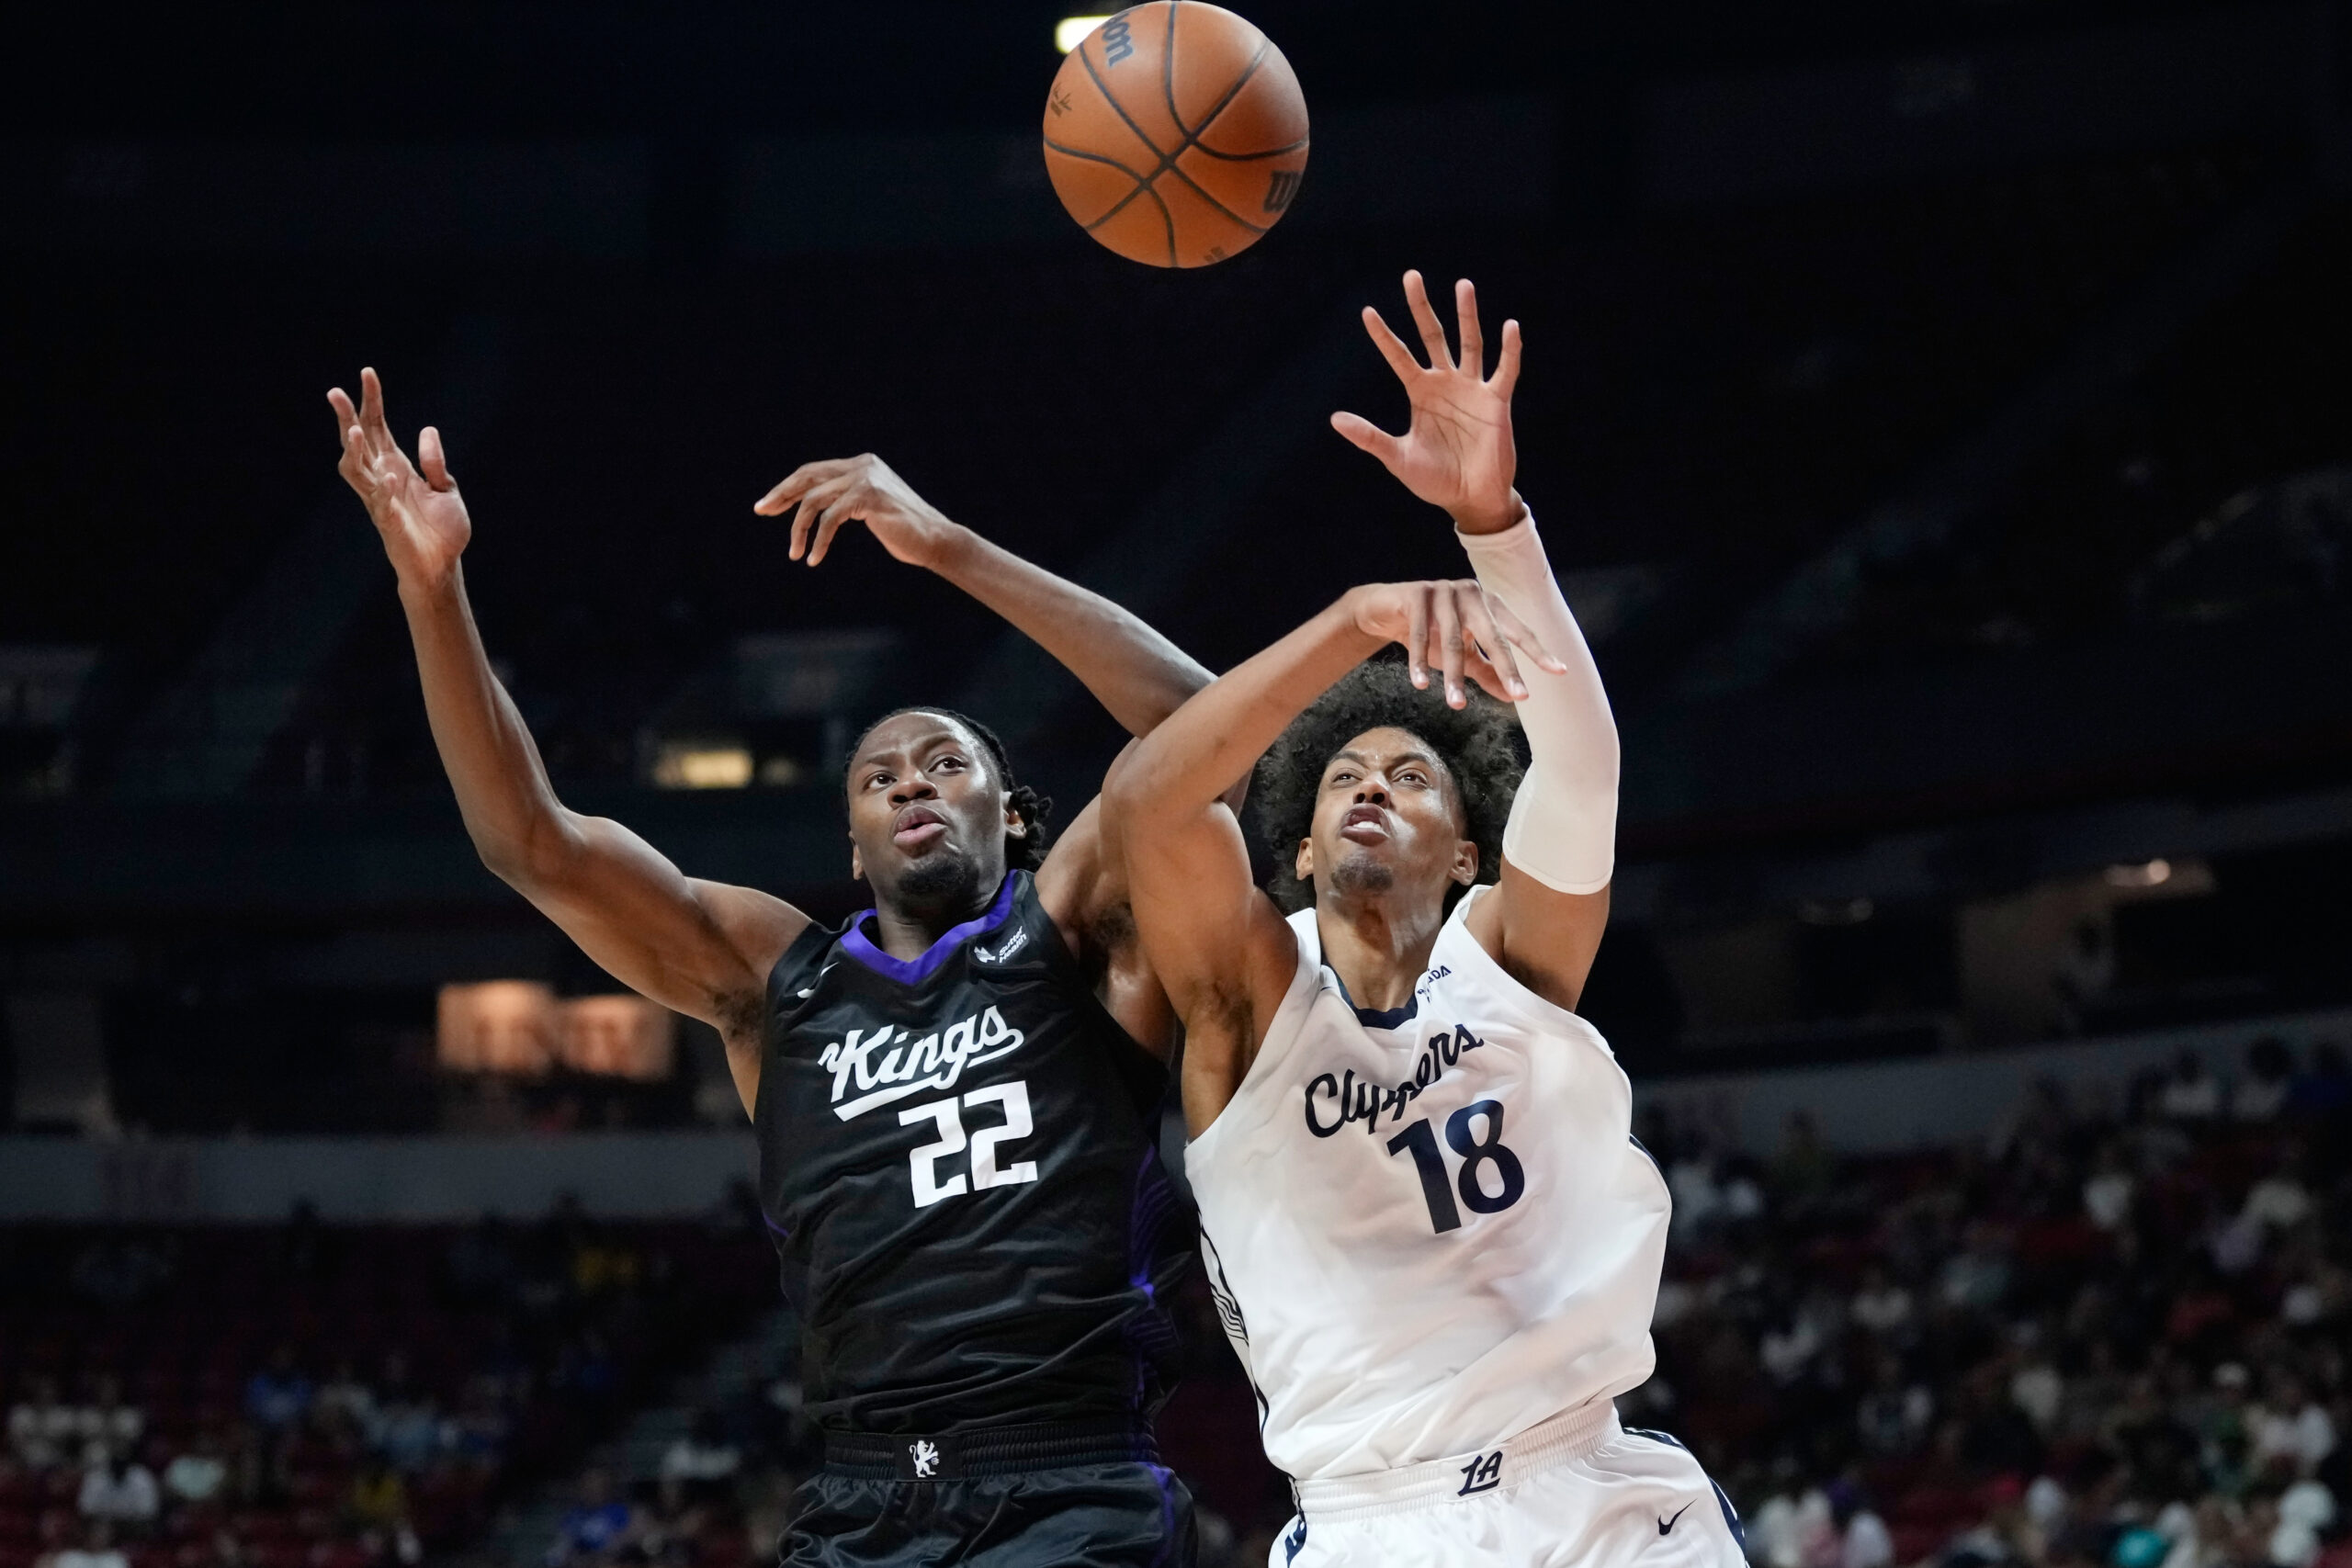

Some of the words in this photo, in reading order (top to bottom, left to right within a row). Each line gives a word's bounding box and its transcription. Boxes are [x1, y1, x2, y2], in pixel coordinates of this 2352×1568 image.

[817, 1005, 1025, 1122] Kings
[898, 1079, 1038, 1209] 22
[1385, 1099, 1525, 1235] 18
[1456, 1450, 1504, 1497] LA
